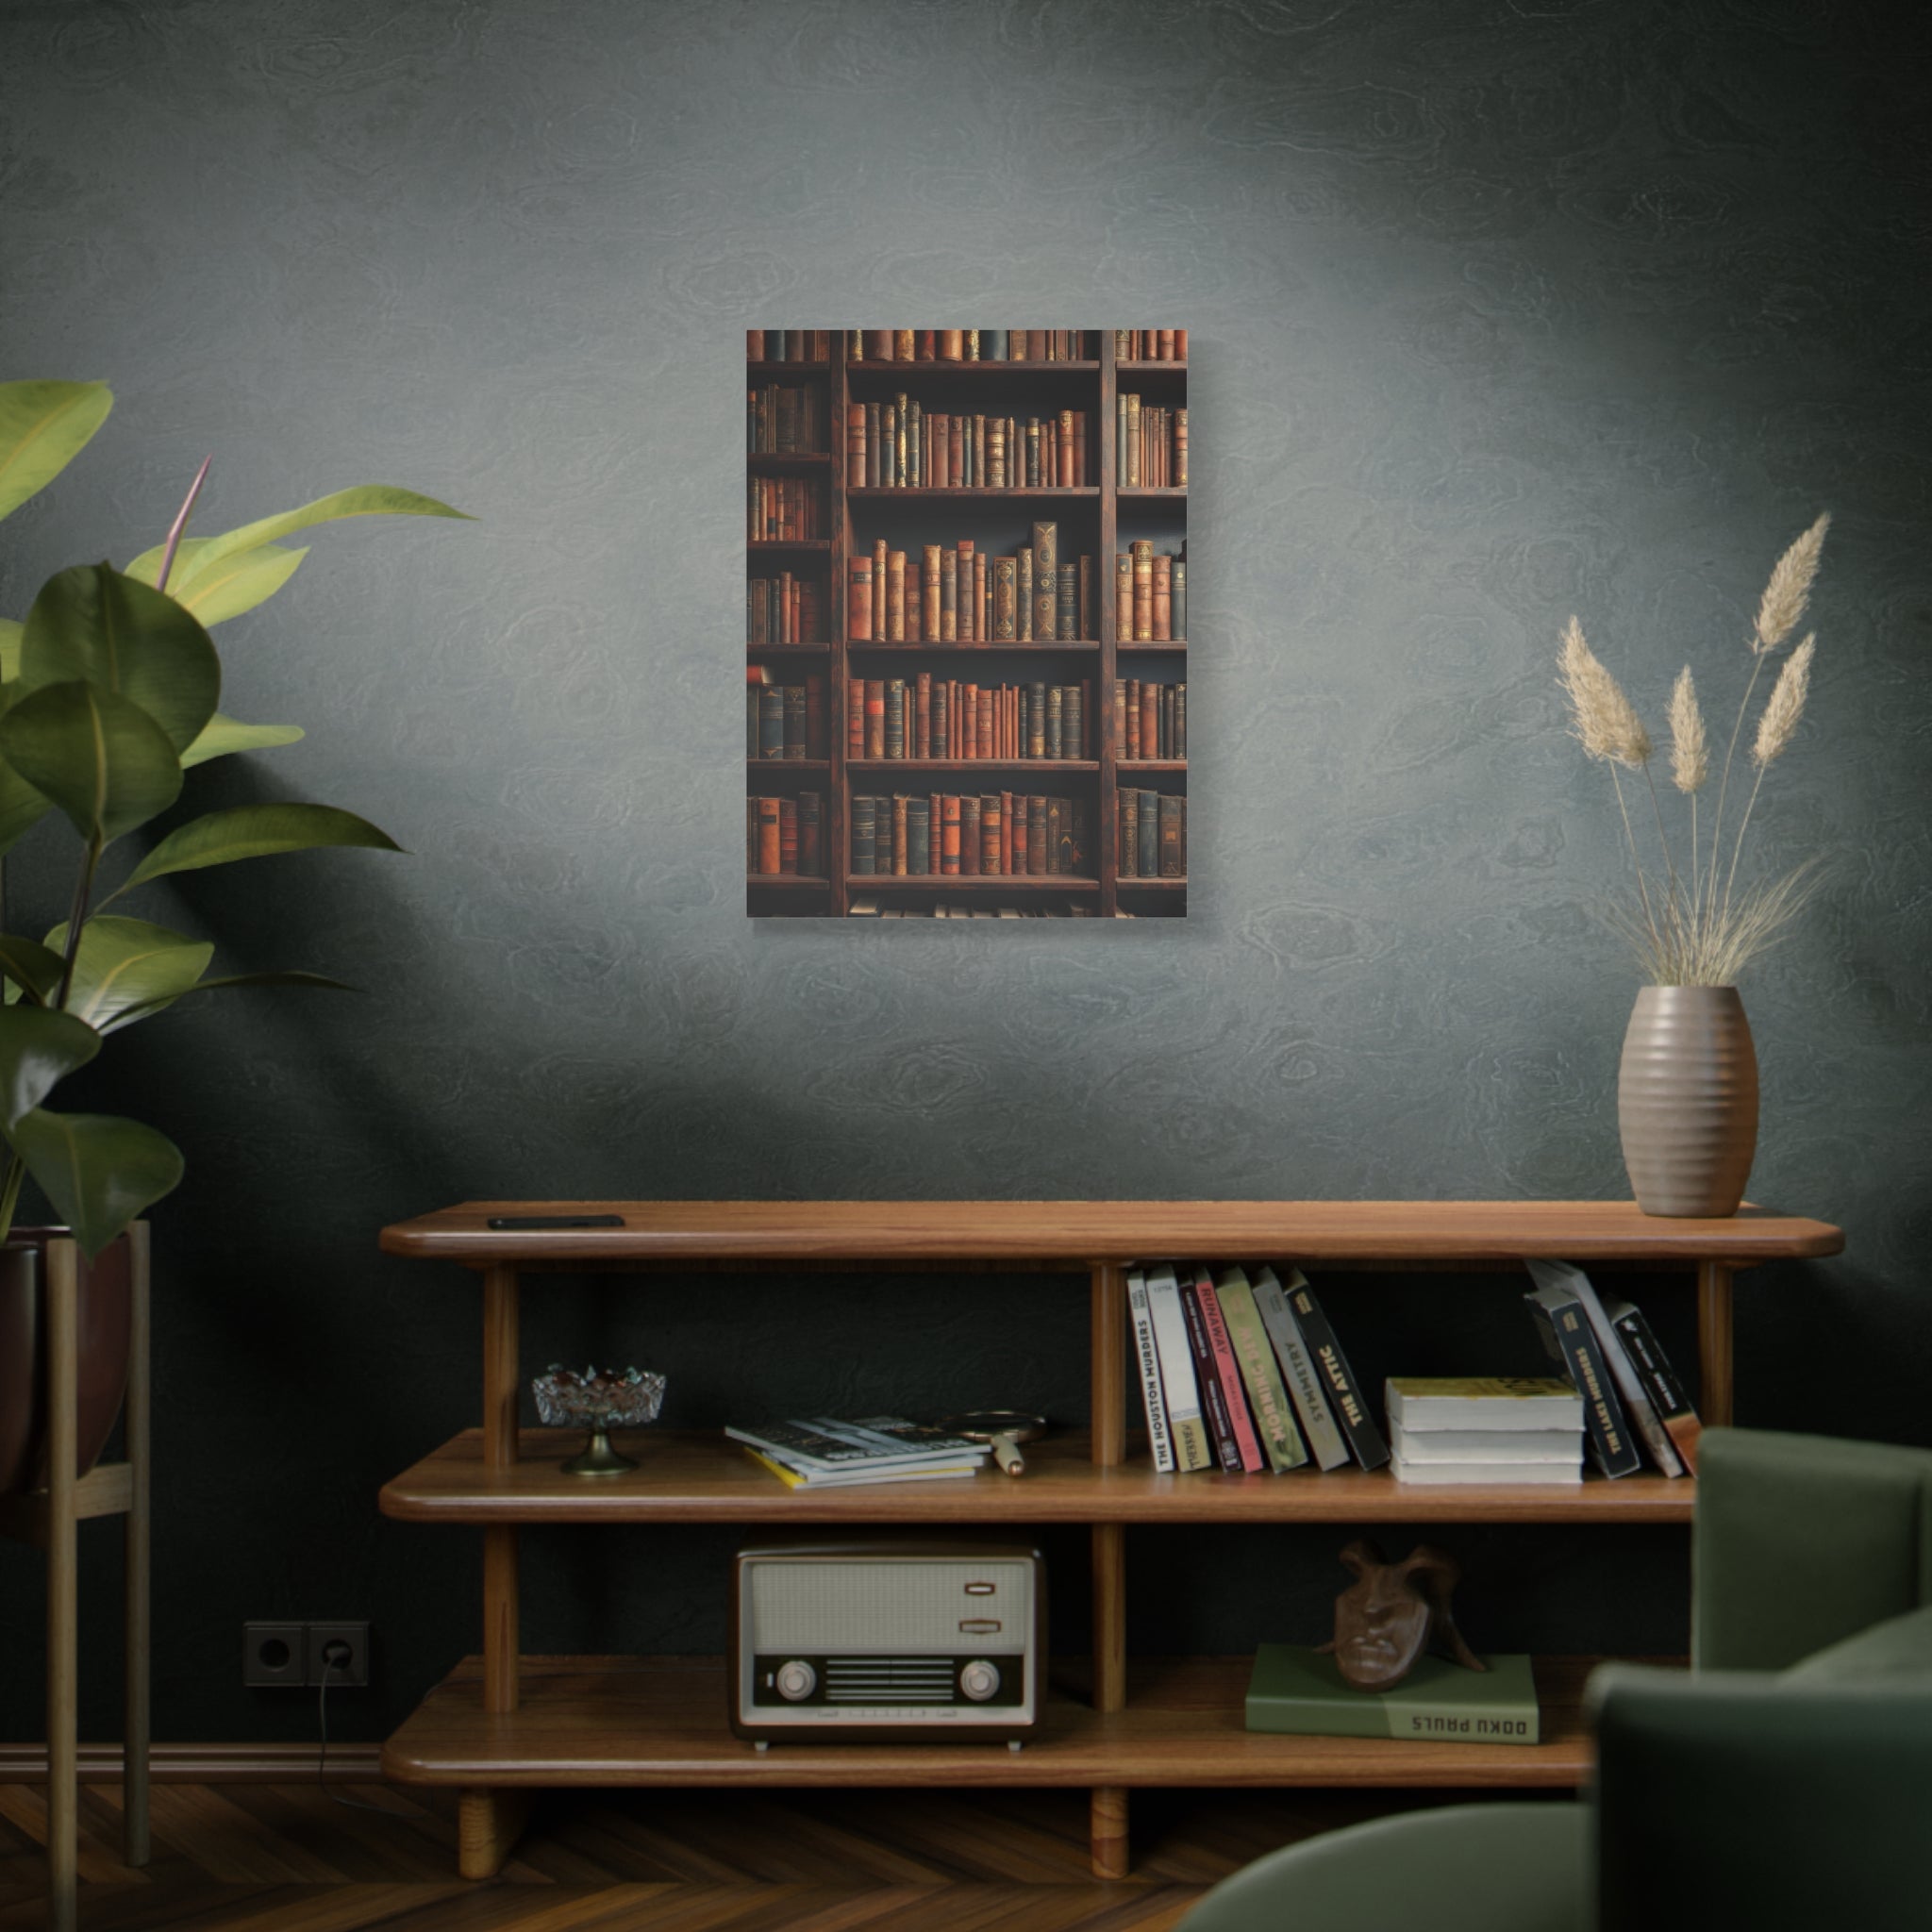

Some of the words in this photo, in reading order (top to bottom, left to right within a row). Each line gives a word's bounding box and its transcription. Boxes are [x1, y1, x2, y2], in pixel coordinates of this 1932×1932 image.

[1201, 1288, 1228, 1355] RUNAWAY
[1138, 1320, 1156, 1377] MURDERS
[1237, 1326, 1260, 1362] DEW
[1285, 1341, 1324, 1423] SYMMETRY
[1319, 1344, 1349, 1391] ATTIC
[1574, 1346, 1603, 1402] MURDERS
[1147, 1380, 1165, 1441] HOUSTON
[1251, 1364, 1287, 1442] MORNING
[1341, 1393, 1363, 1427] THE
[1594, 1400, 1613, 1431] LAKE
[1157, 1442, 1169, 1467] THE
[1606, 1430, 1622, 1456] THE
[1411, 1716, 1470, 1733] PAULS
[1476, 1719, 1527, 1735] DOKU
